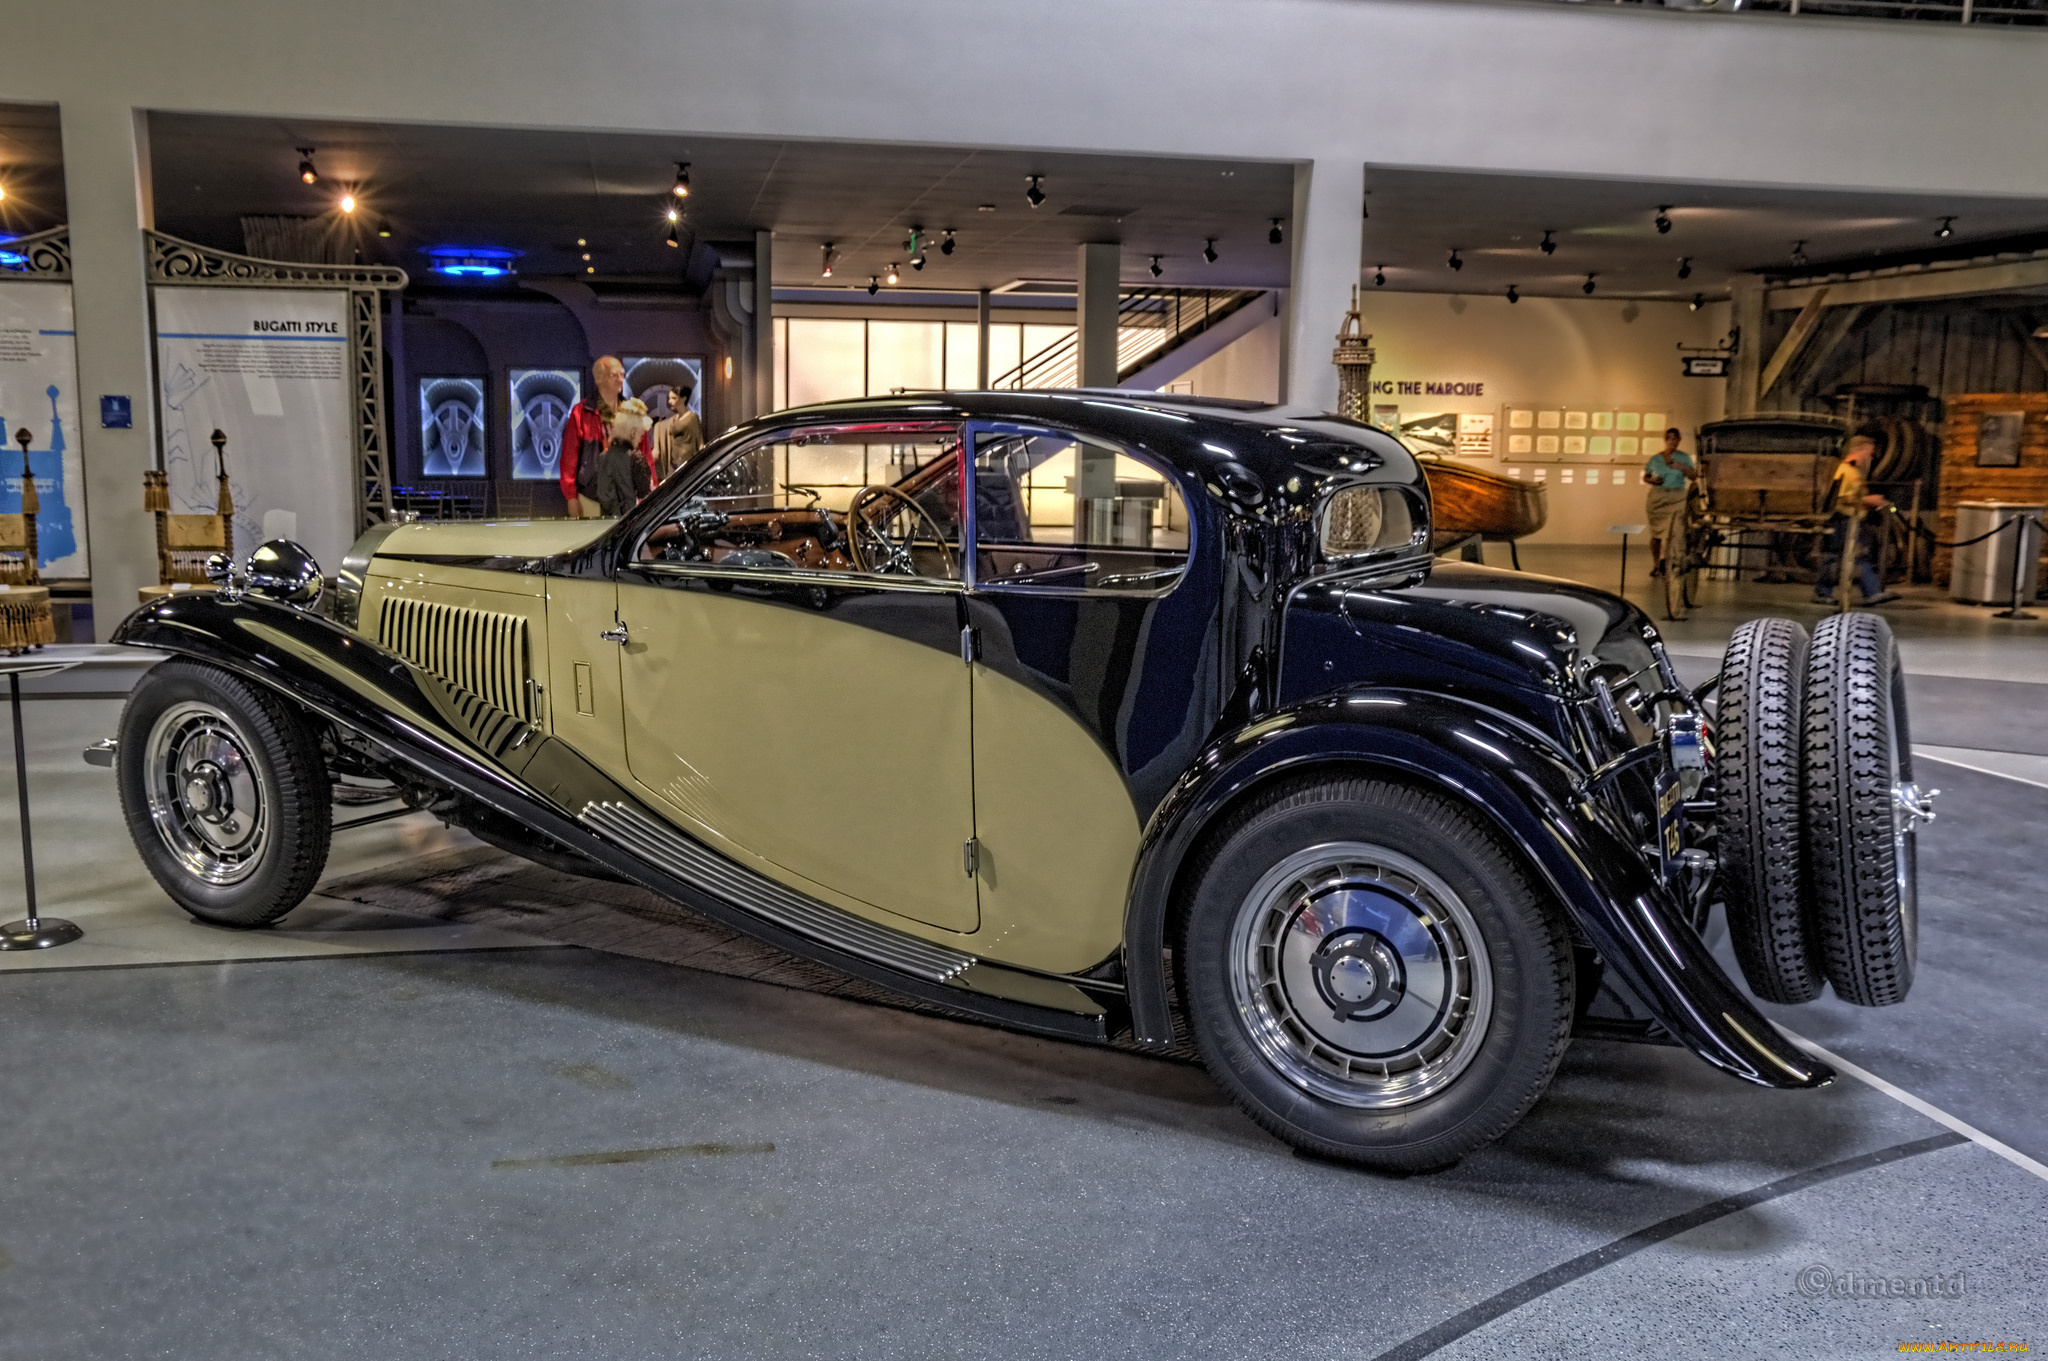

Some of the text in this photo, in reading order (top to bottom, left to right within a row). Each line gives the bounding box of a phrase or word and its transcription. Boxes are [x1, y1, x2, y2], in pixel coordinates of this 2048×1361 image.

[253, 320, 338, 333] BUGATTI STYLE
[1398, 381, 1422, 395] THE
[1425, 382, 1484, 396] MARQUE
